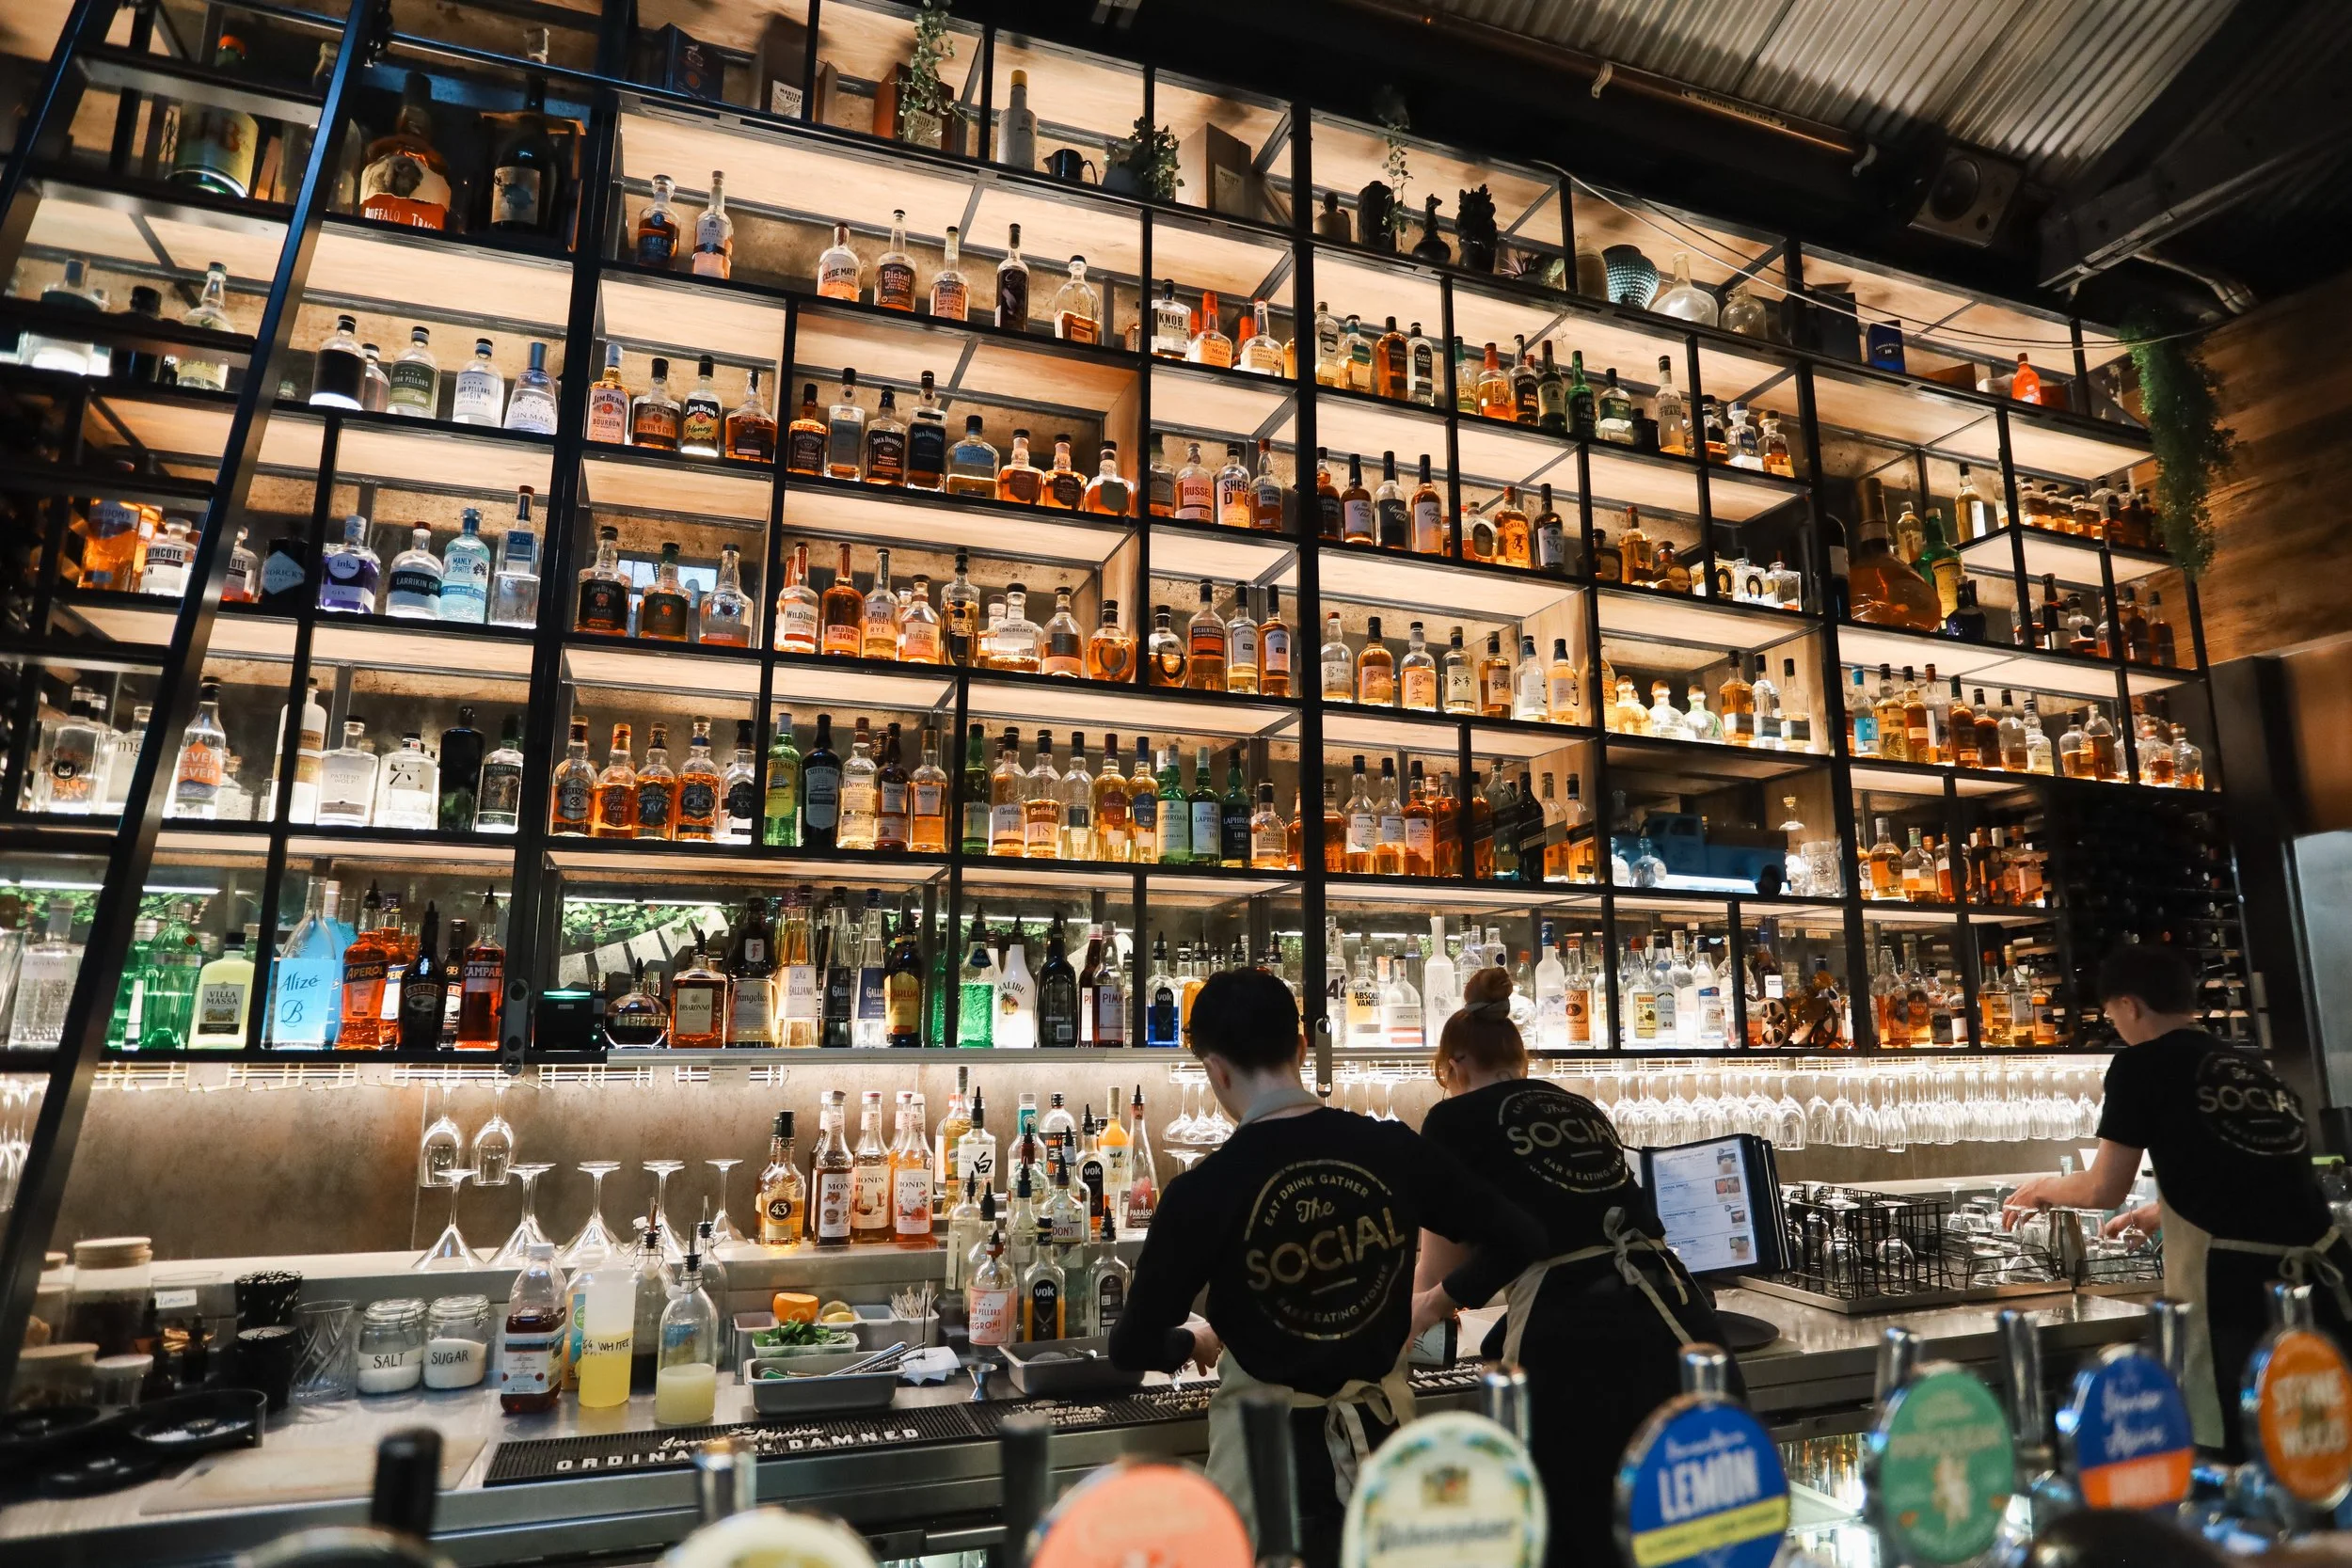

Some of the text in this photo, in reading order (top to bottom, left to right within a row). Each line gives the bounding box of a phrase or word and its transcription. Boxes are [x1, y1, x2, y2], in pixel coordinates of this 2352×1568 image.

[884, 270, 911, 282] Dickel
[1159, 312, 1184, 326] KNOB
[1163, 324, 1187, 332] CREEK
[1211, 348, 1231, 357] Mark
[592, 393, 625, 409] JIM BEAM
[687, 404, 716, 417] JIM BEAM
[530, 413, 552, 425] MAR
[594, 418, 621, 428] BOURBON
[685, 423, 713, 435] Honey
[874, 436, 884, 446] JACK
[453, 557, 472, 566] MANLY
[453, 565, 471, 575] SPIRITS
[395, 578, 427, 588] LARRIKIN
[787, 610, 803, 619] WILD
[868, 616, 890, 626] TURKEY
[951, 622, 973, 631] HONEY
[832, 626, 844, 634] WILD
[608, 804, 628, 813] Extra
[646, 803, 662, 815] XV
[737, 800, 750, 809] XX
[345, 965, 384, 978] APEROL
[464, 966, 504, 978] CAMPARI
[277, 971, 323, 991] Alizé
[208, 990, 237, 999] VILLA
[734, 989, 770, 1004] Frangelico
[788, 986, 814, 997] GALLIANO
[832, 985, 848, 997] GALLI
[1355, 991, 1379, 1000] ABSOLU
[205, 996, 239, 1006] MASSA
[1102, 992, 1123, 1004] PIMM
[1155, 994, 1172, 1003] vok
[1538, 1103, 1571, 1115] The
[1506, 1117, 1622, 1156] SOCIAL
[1084, 1165, 1101, 1176] vok
[1543, 1156, 1611, 1181] BAR & EATING
[1263, 1173, 1370, 1227] EAT DRINK GATHER
[771, 1202, 788, 1216] 43
[1129, 1208, 1153, 1217] PARAISO
[1295, 1196, 1336, 1224] The
[1051, 1225, 1074, 1235] DON'S
[1245, 1206, 1406, 1292] SOCIAL
[1035, 1285, 1055, 1297] vok
[1313, 1263, 1390, 1323] EATING HOUSE
[977, 1307, 1000, 1317] PILLARS
[373, 1352, 405, 1370] SALT
[431, 1349, 469, 1366] SUGAR
[556, 1428, 919, 1471] ORDINA DAMNED
[1656, 1445, 1761, 1524] LEMON
